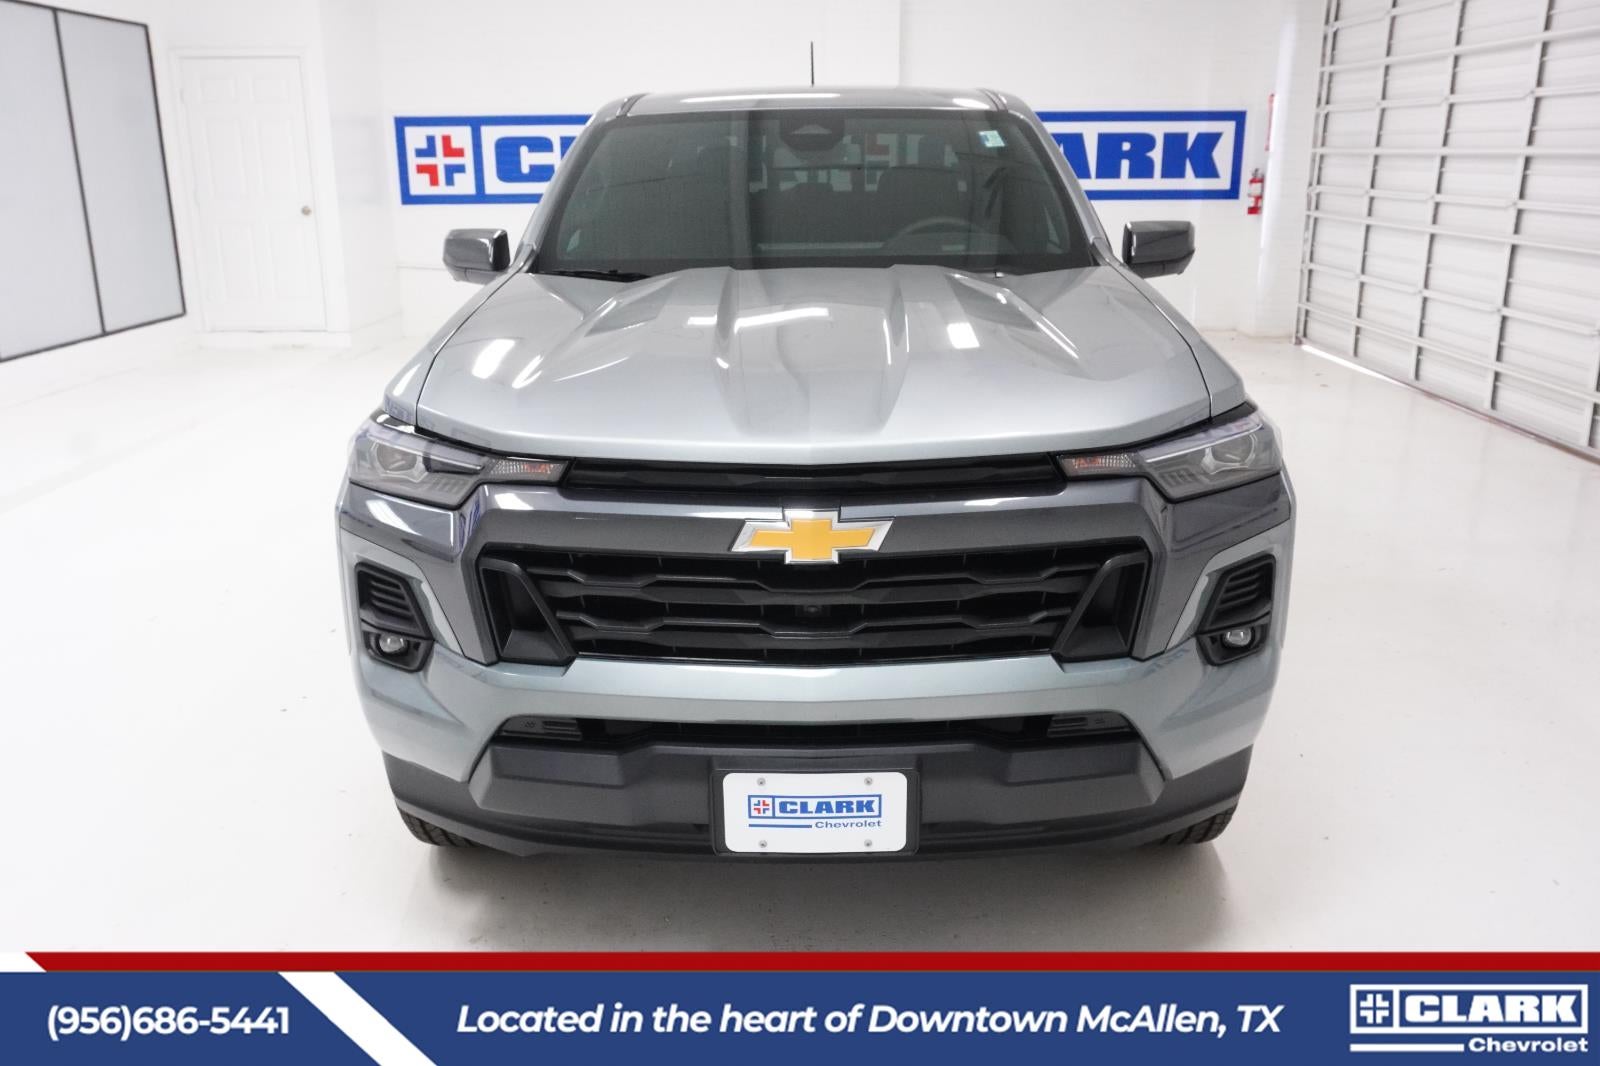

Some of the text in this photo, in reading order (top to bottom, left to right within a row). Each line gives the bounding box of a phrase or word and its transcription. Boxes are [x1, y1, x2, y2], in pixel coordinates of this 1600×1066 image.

[1050, 132, 1223, 180] ARK
[778, 800, 876, 815] CLARK
[814, 819, 883, 830] Chevrolet
